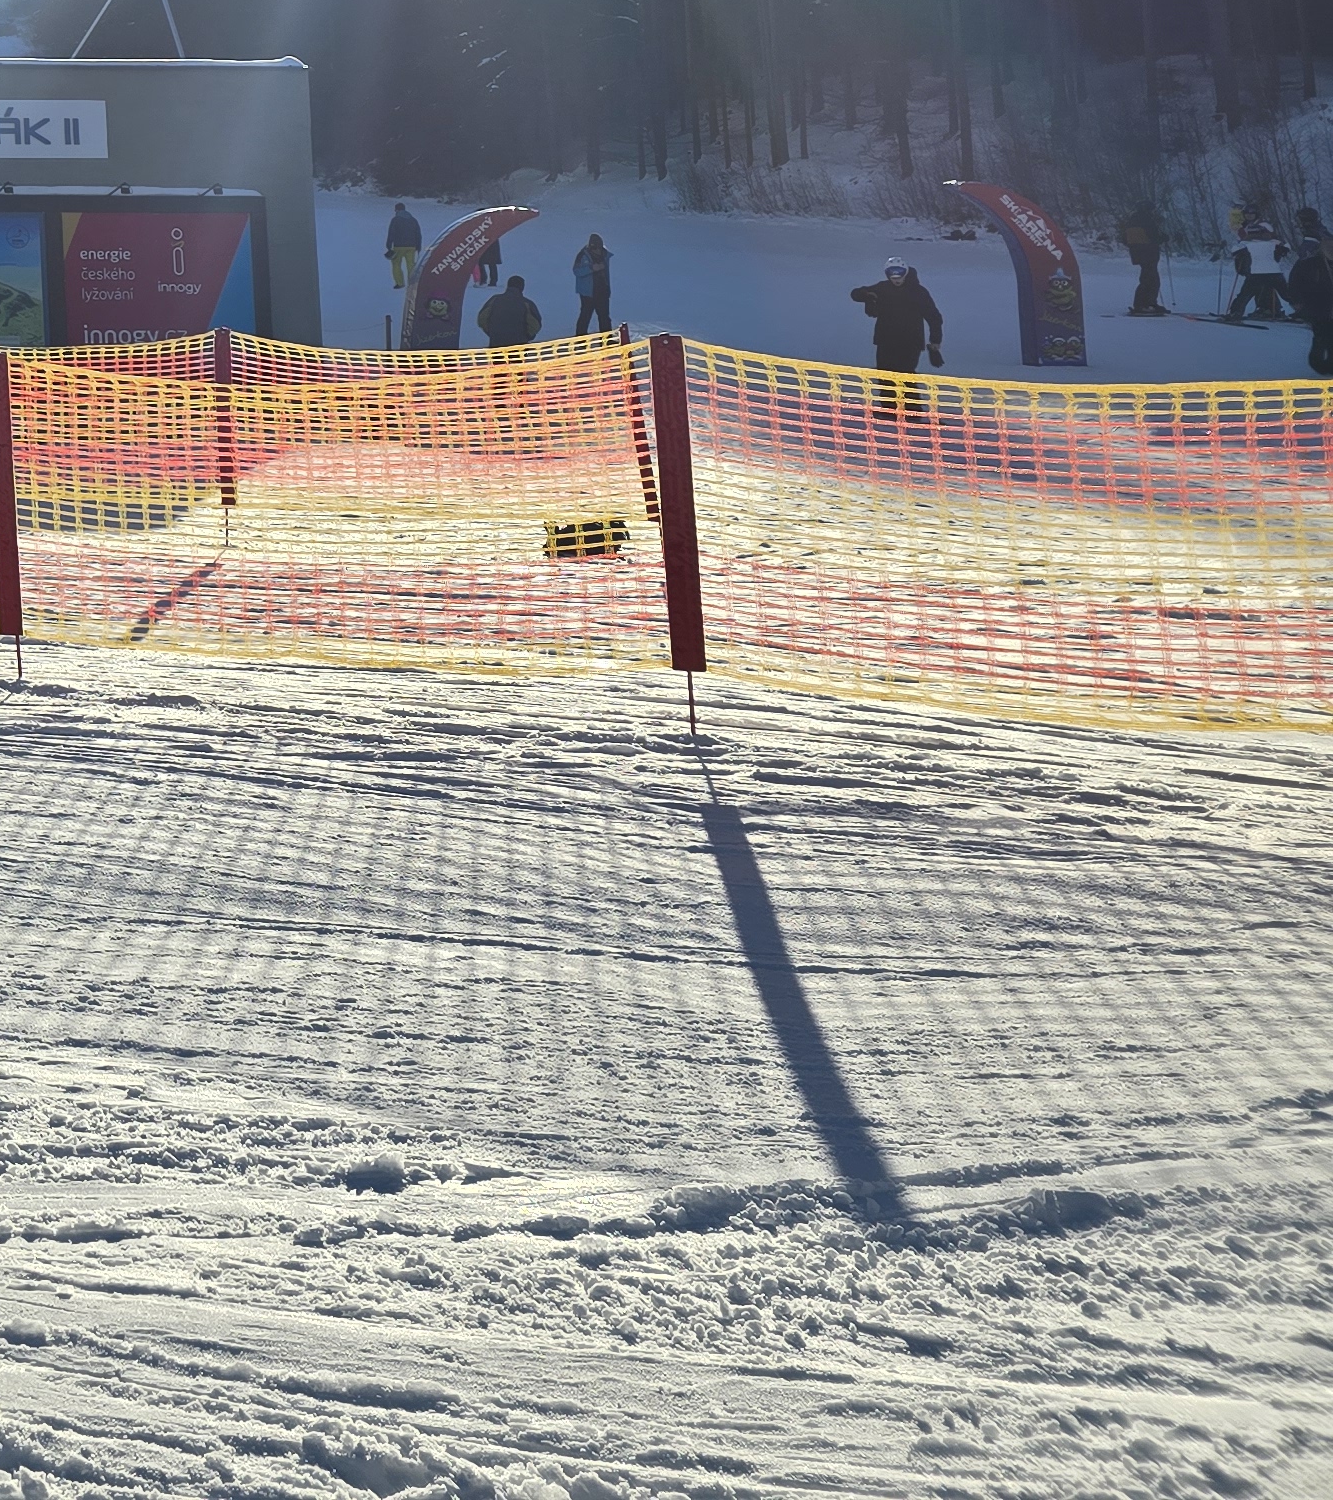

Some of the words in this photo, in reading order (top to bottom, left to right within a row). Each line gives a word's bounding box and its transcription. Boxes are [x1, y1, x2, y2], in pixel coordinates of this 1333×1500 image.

[64, 118, 80, 146] II
[431, 216, 493, 275] TANVALDSKÝ
[450, 235, 489, 272] ŠPIČÁK
[80, 248, 131, 263] energie
[81, 267, 135, 280] českého
[82, 287, 133, 303] lyžování
[158, 281, 201, 295] innogy
